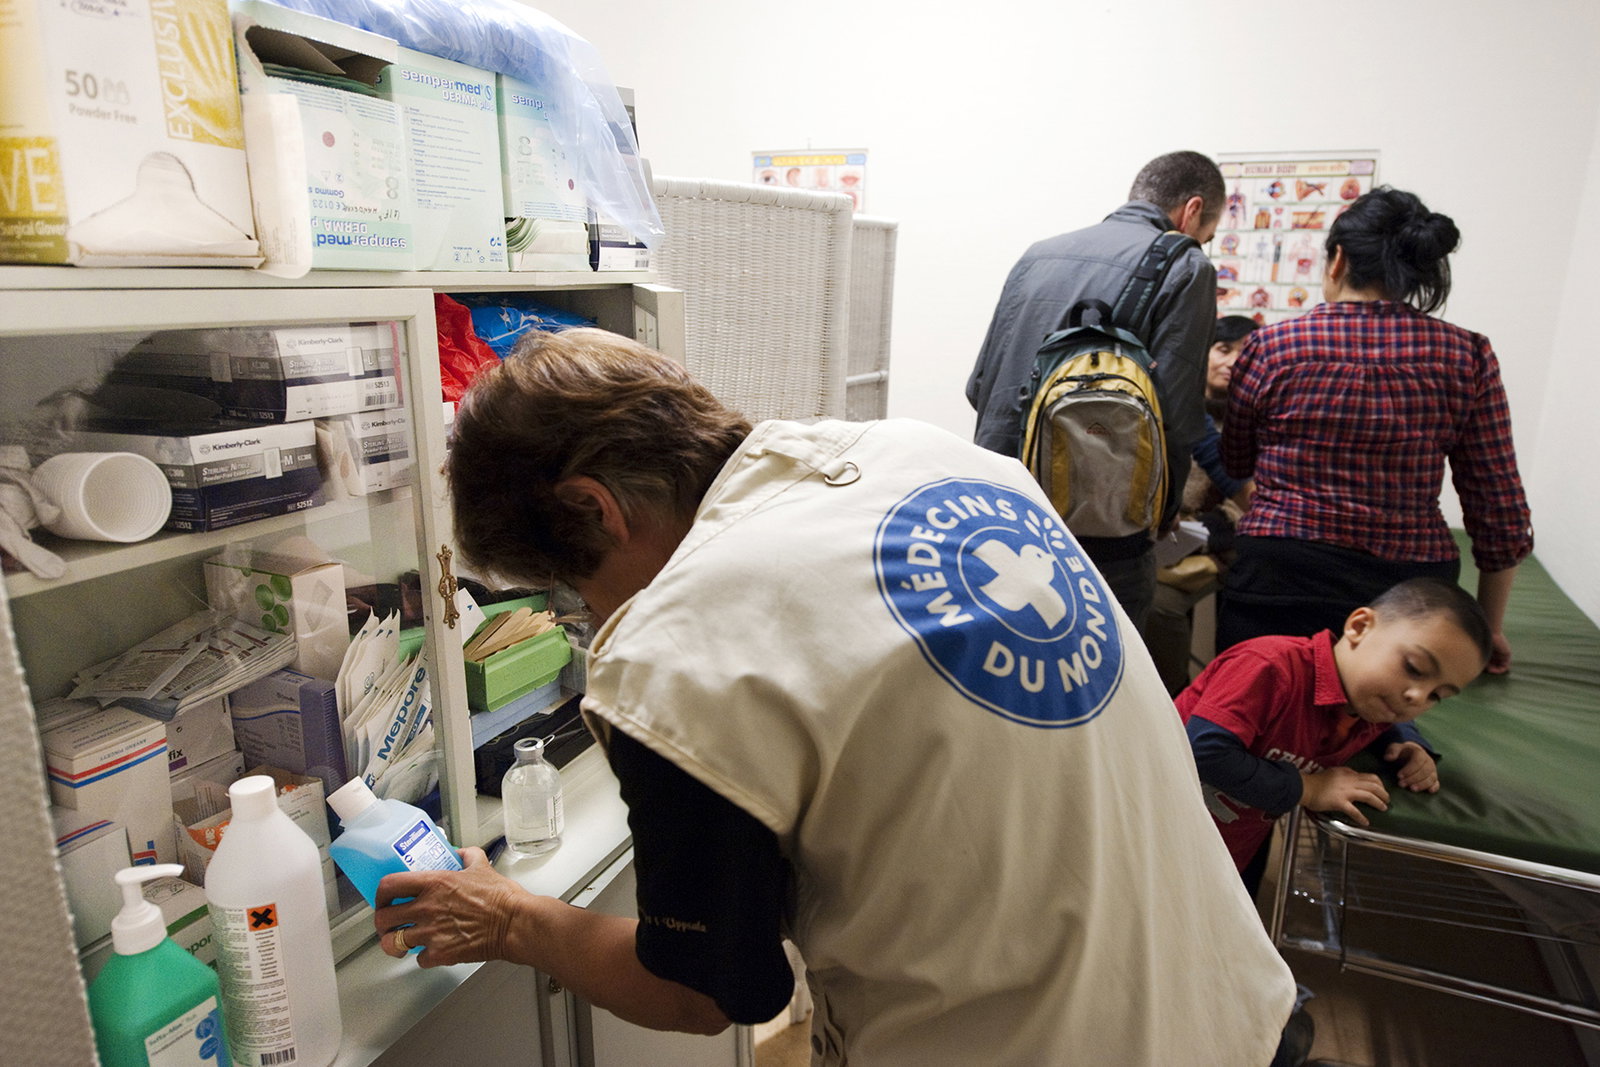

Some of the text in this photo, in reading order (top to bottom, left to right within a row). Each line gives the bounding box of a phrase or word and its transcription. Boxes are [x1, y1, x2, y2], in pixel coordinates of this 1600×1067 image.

[65, 69, 98, 99] 50
[400, 69, 482, 96] sempermed
[442, 90, 478, 107] DERMA
[511, 93, 545, 110] semp
[69, 103, 138, 125] Powder Free
[1276, 165, 1297, 173] BODY
[315, 186, 345, 199] Gamma
[312, 199, 332, 210] 0123
[322, 220, 368, 234] DERMA
[315, 233, 407, 249] sempermed
[298, 336, 343, 347] Kimberly-Clark
[211, 438, 261, 452] Kimberly-Clark
[284, 455, 293, 466] M
[901, 495, 1108, 693] MÉDECINS DU MONDE
[377, 667, 426, 761] Mepore
